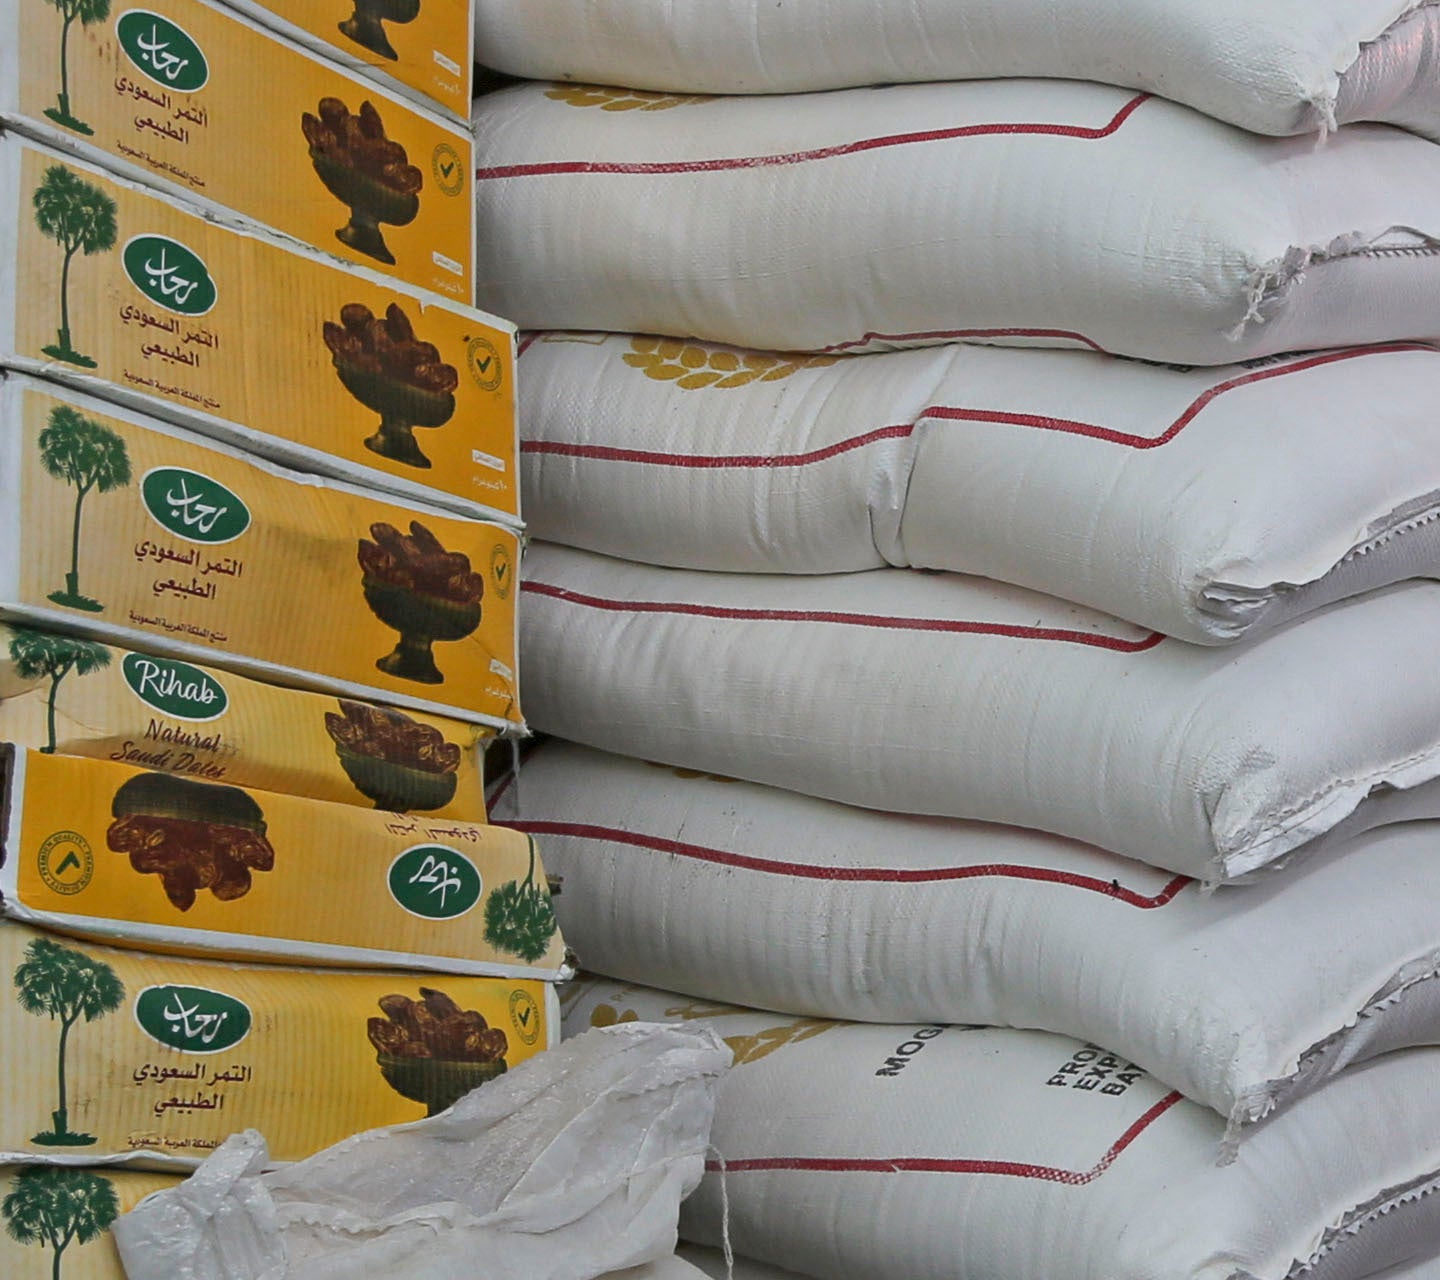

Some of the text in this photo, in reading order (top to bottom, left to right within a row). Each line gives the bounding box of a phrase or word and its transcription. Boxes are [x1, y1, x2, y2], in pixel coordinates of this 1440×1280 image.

[114, 75, 208, 127] التمر السعودي
[133, 113, 189, 144] الطبيعي
[119, 303, 219, 349] التمر السعودي
[141, 339, 200, 368] الطبيعي
[134, 539, 243, 578] التمر السعودي
[152, 577, 217, 601] الطبيعي
[135, 659, 219, 705] Rihab
[143, 717, 223, 752] Natural
[110, 740, 227, 780] Saudi Dates
[875, 1023, 951, 1076] MOG
[131, 1062, 252, 1086] التمر السعودي
[153, 1093, 225, 1115] الطبيعي
